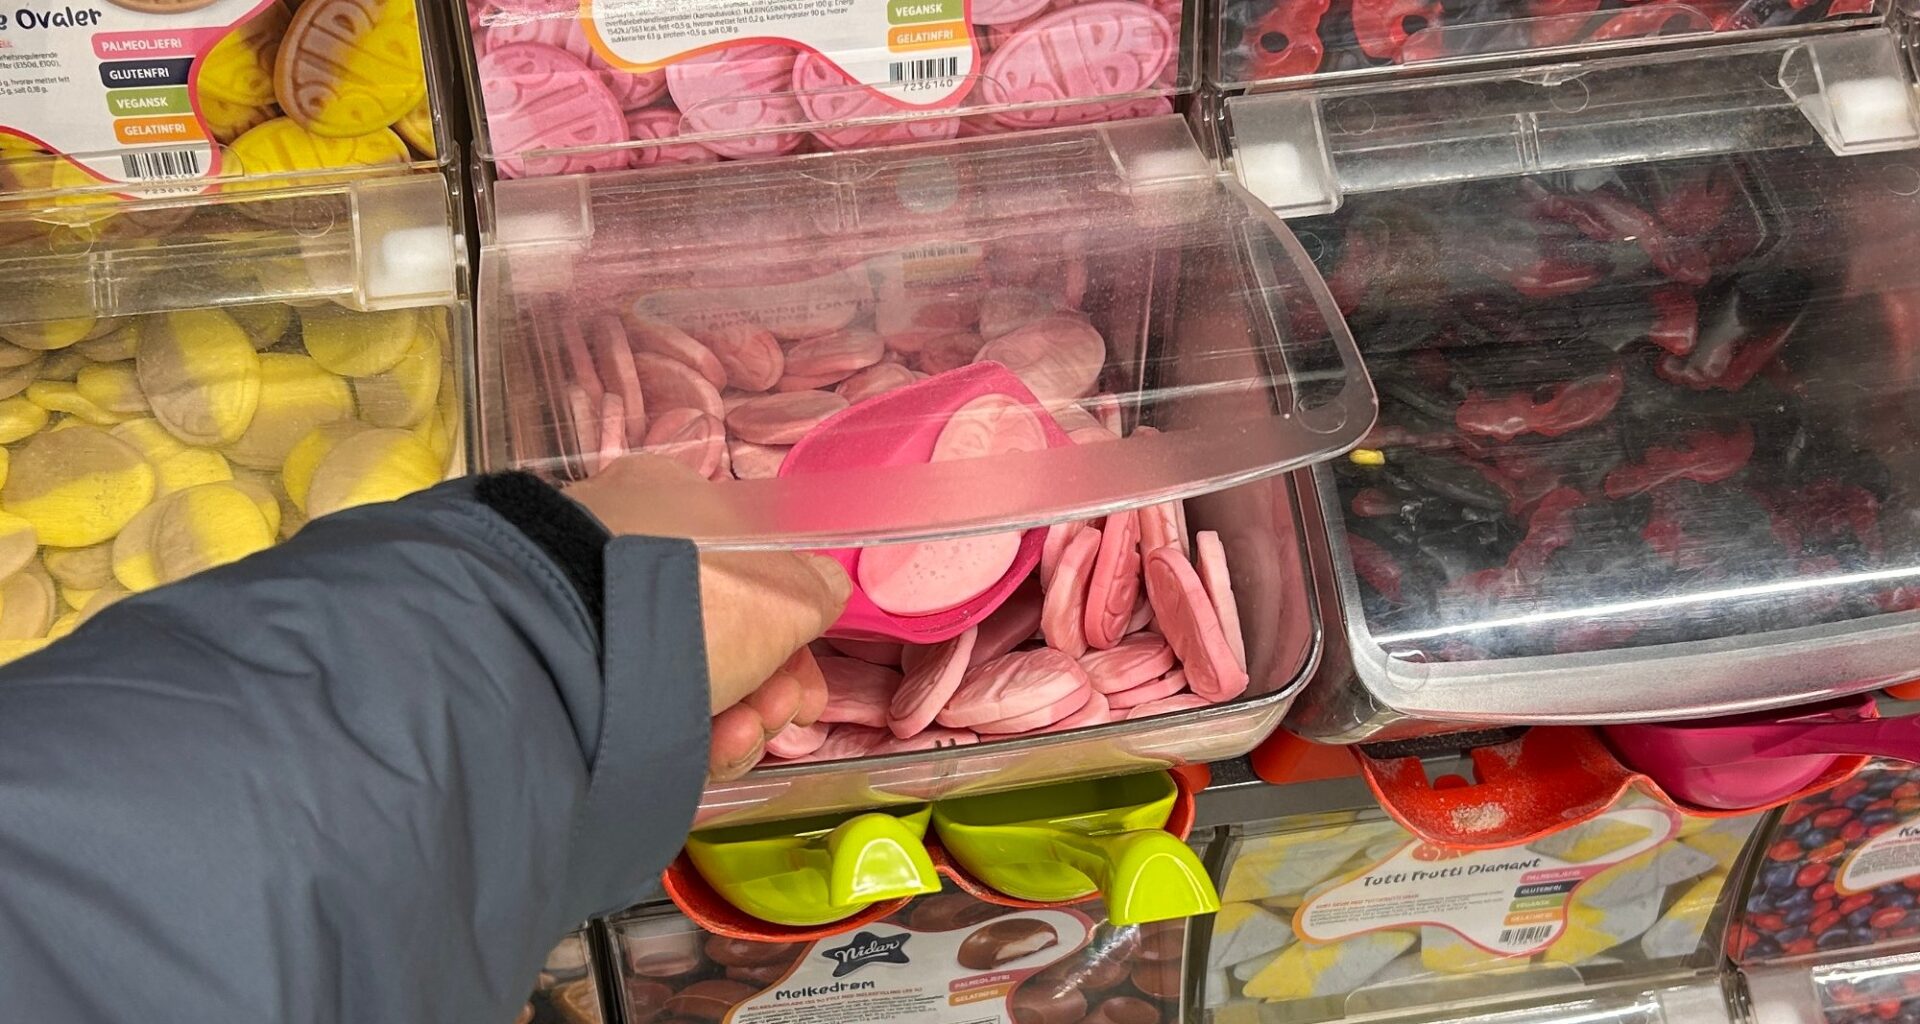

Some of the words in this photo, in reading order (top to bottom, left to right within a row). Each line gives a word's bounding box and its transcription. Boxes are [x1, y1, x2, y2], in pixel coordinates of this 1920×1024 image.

[895, 3, 943, 17] VEGANSK
[15, 6, 102, 30] Ovaler
[897, 29, 954, 44] GELATINFRI
[101, 38, 182, 52] PALMEOLJEFRI
[109, 67, 170, 80] GLUTENFRI
[903, 79, 954, 92] 7236140
[116, 97, 168, 109] VEGANSK
[124, 123, 186, 136] GELATINFRI
[1363, 873, 1406, 887] Tutti
[1411, 866, 1462, 882] Frutti
[1467, 858, 1542, 876] Diamant
[834, 940, 900, 962] Nidar
[775, 980, 875, 1000] Melkedrøm
